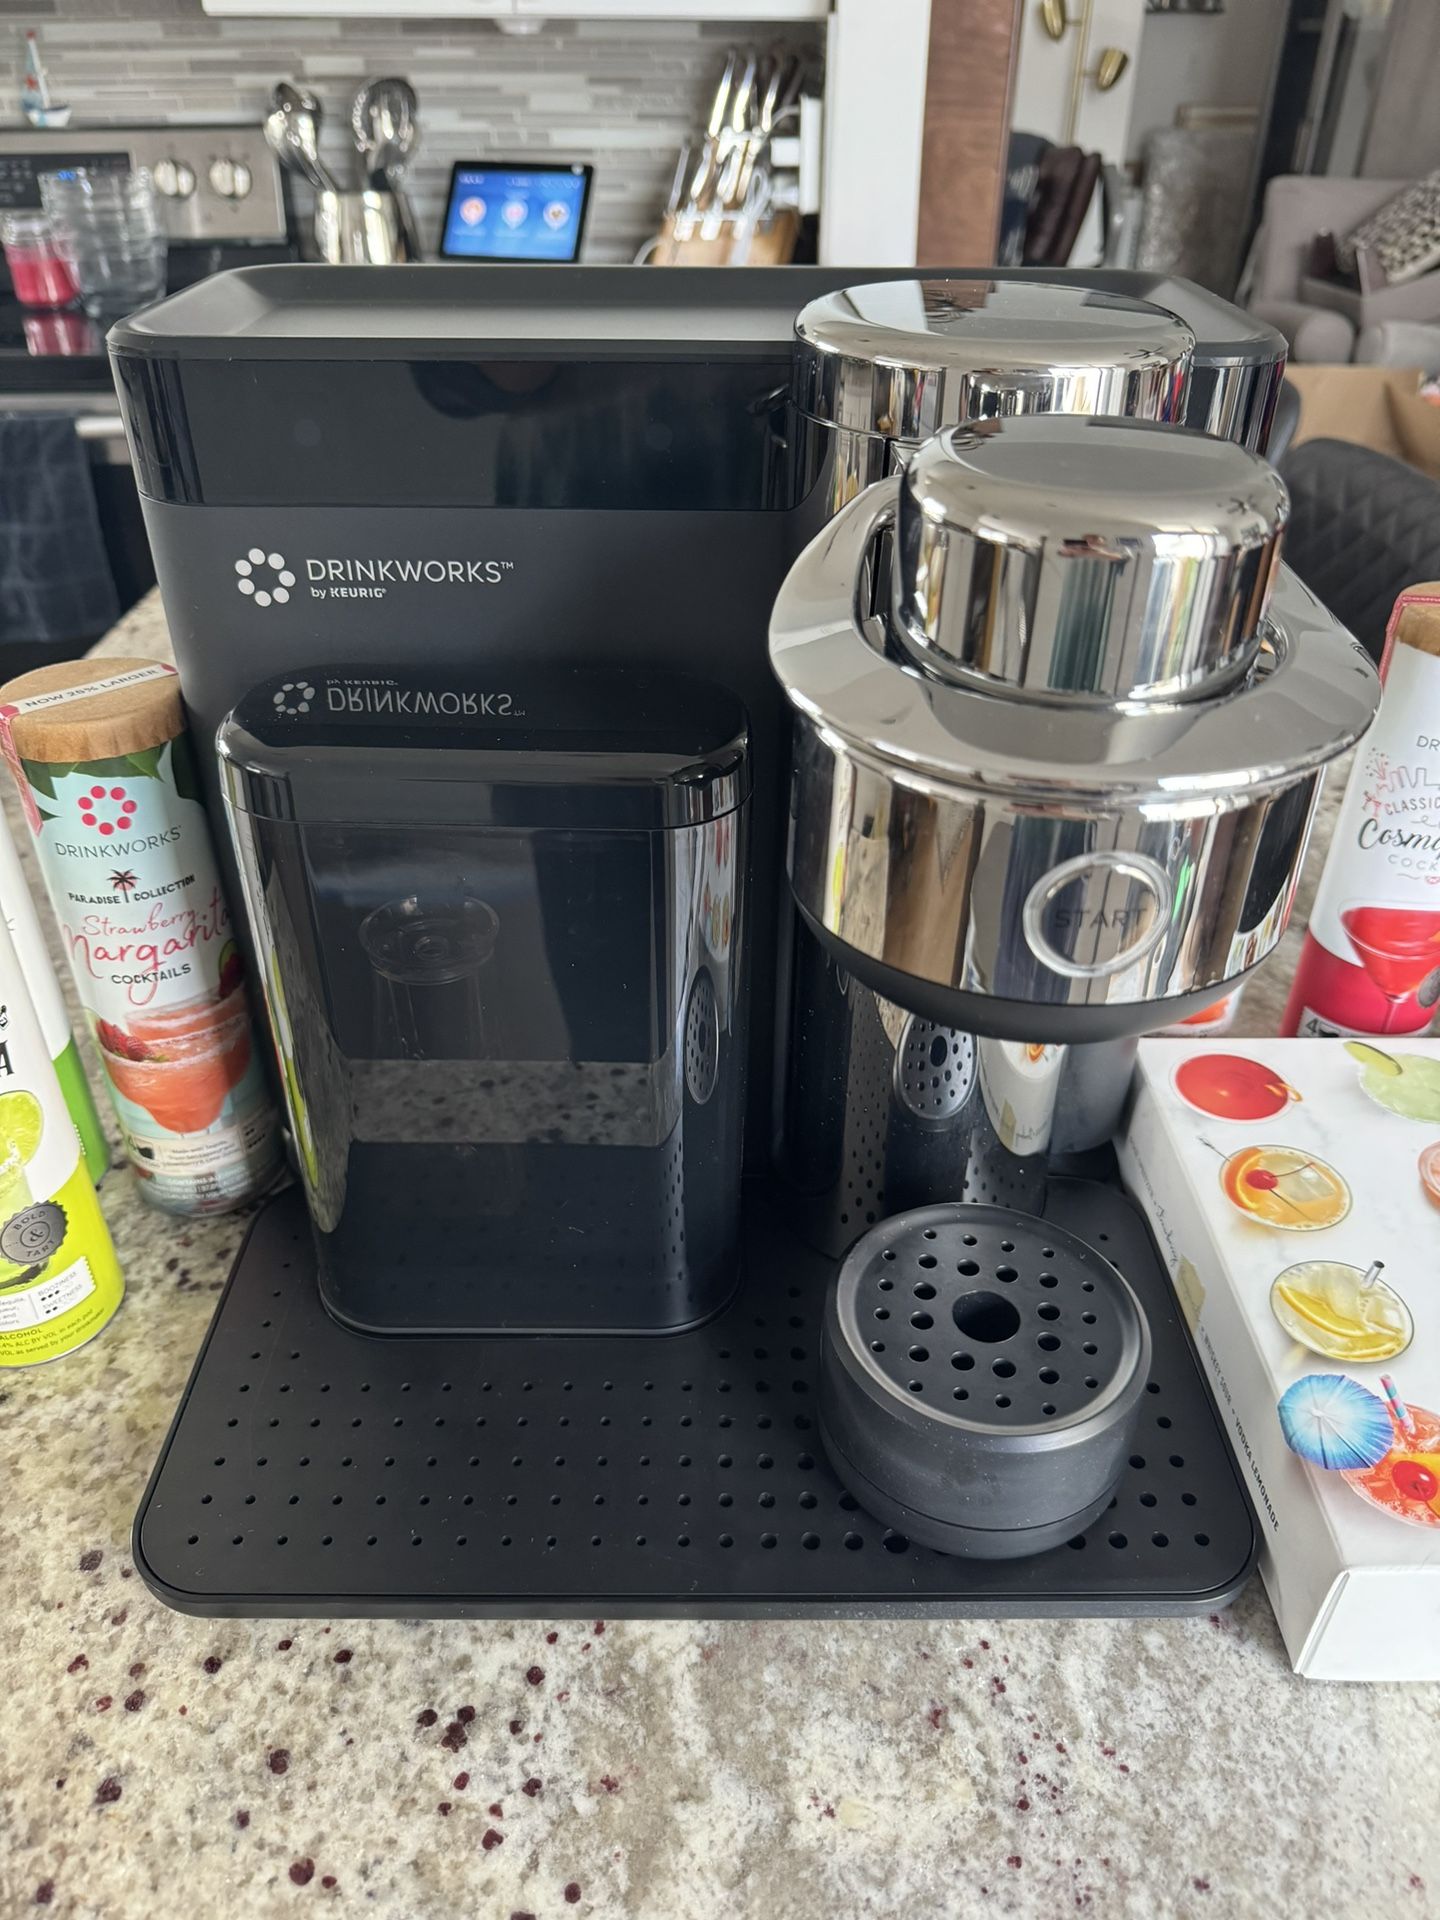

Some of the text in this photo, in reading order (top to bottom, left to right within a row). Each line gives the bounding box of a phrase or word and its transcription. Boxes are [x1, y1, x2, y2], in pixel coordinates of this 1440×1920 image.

[311, 587, 327, 600] by
[25, 694, 64, 707] NOW
[100, 670, 159, 689] LARGER
[68, 874, 196, 905] PARADISE COLLECTION
[83, 902, 197, 936] Strawberry
[1055, 908, 1148, 929] START
[111, 963, 192, 985] COCKTAILS
[13, 1210, 46, 1231] BOLD
[30, 1229, 45, 1242] &
[26, 1240, 54, 1257] TART
[0, 1328, 43, 1341] ALCOHOL
[1234, 1417, 1252, 1462] VODKA
[1251, 1460, 1280, 1533] LEMONADE
